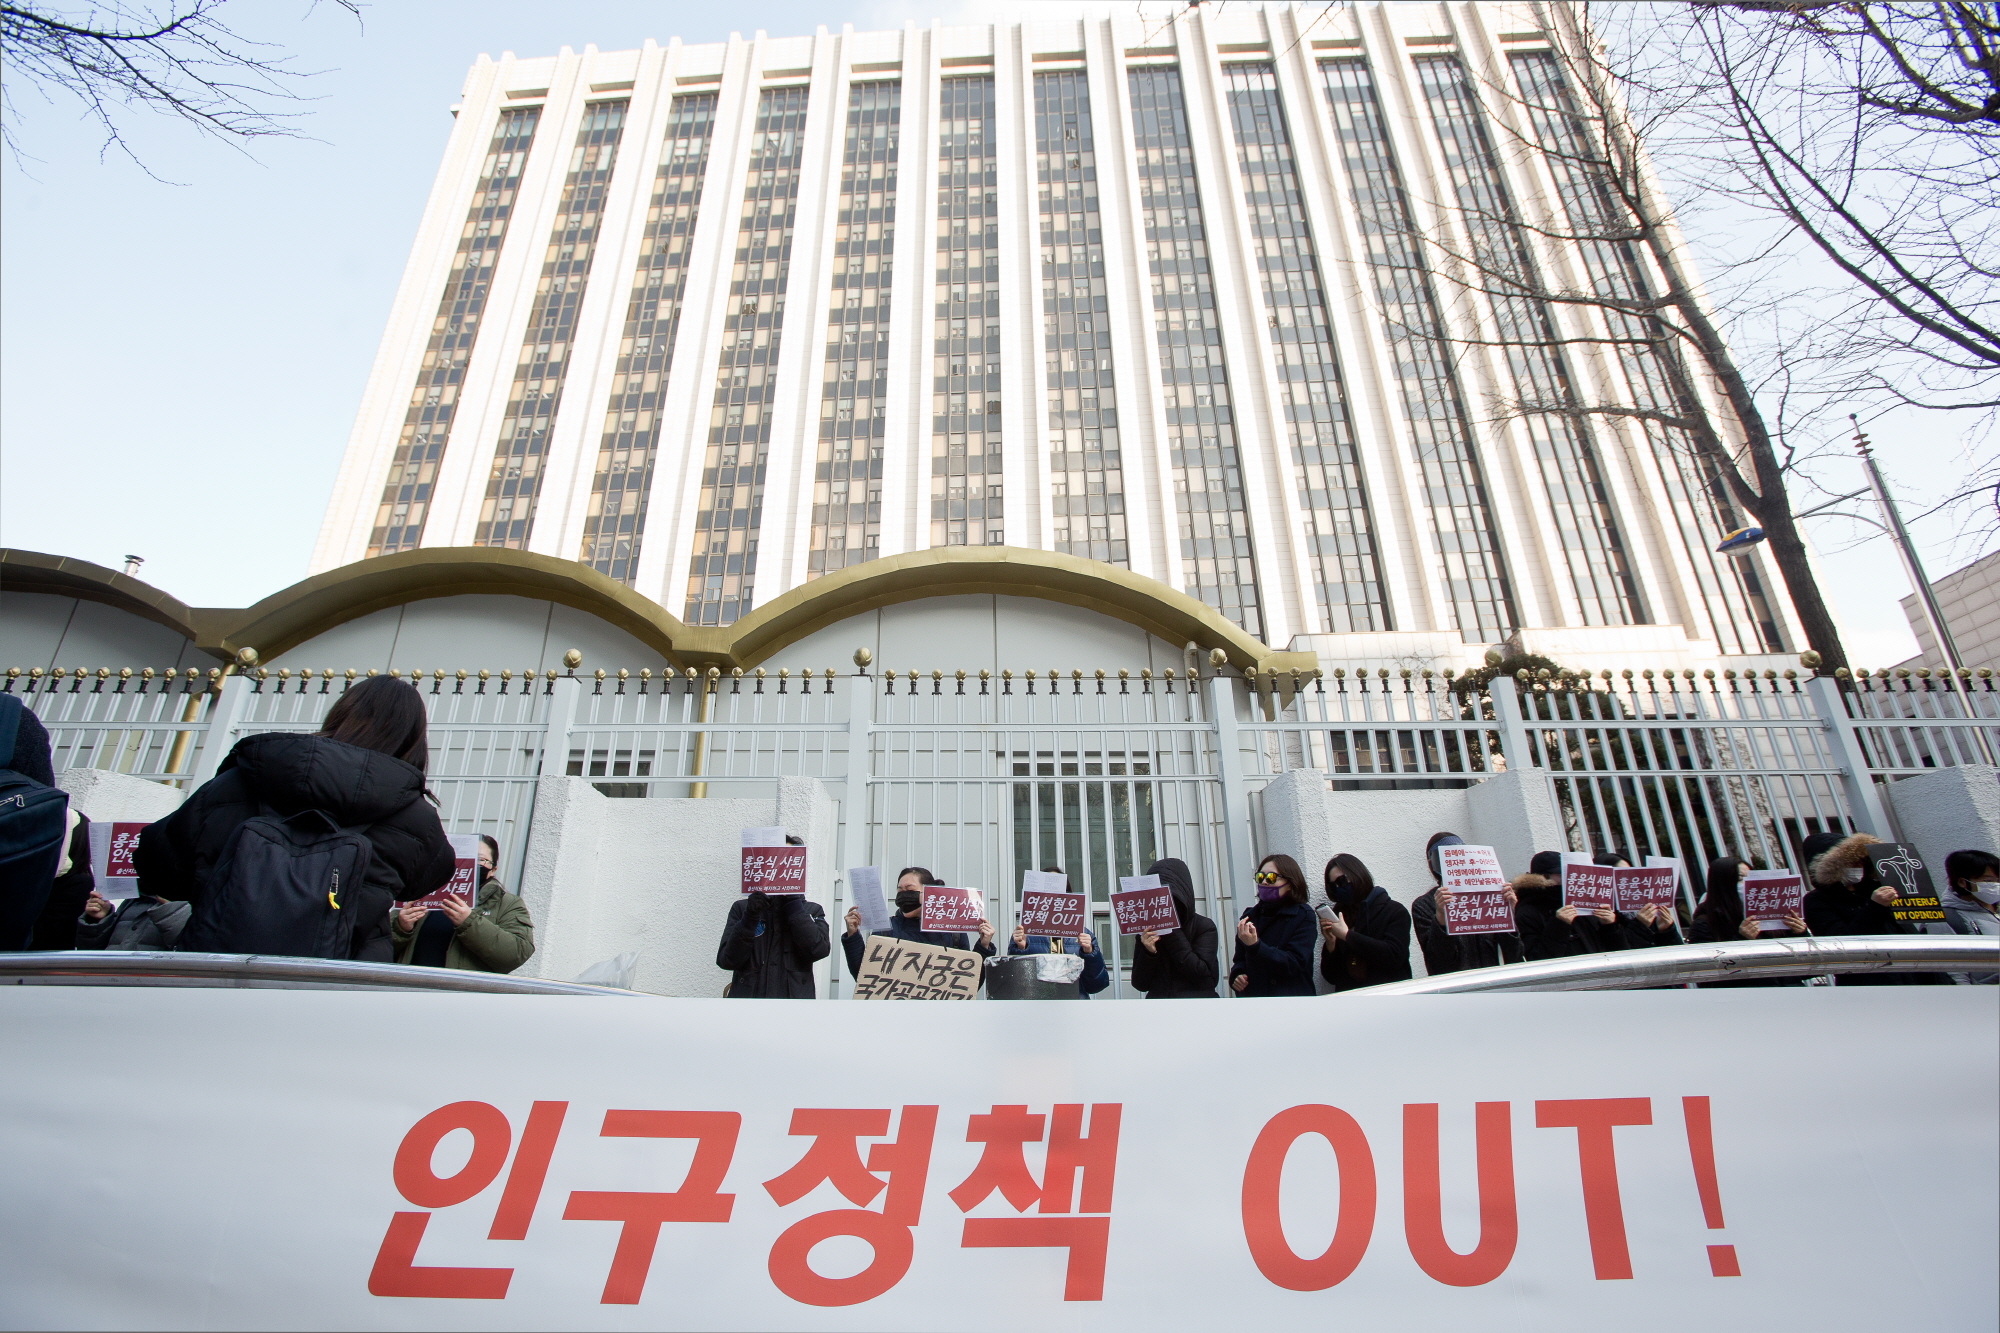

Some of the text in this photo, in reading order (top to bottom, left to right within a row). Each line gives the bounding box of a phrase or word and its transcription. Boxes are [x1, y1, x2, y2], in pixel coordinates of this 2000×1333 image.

[112, 833, 141, 848] 홍윤
[743, 856, 804, 869] 홍윤식 사퇴
[744, 868, 804, 882] 안승대 사퇴
[1568, 872, 1613, 887] 홍윤식 사퇴
[1617, 875, 1672, 890] 홍윤식 사퇴
[442, 882, 472, 895] 사퇴
[1568, 885, 1613, 899] 안승대 사퇴
[1620, 887, 1673, 901] 안승대 사퇴
[1746, 885, 1800, 900] 홍윤식 사퇴
[925, 894, 958, 908] 홍윤식
[1027, 896, 1078, 912] 여성혐오
[1116, 895, 1169, 913] 홍윤식 사퇴
[1447, 894, 1504, 909] 홍윤식 사퇴
[1748, 897, 1800, 911] 안승대 사퇴
[1891, 897, 1938, 907] MY UTERUS
[925, 908, 958, 920] 안승대
[1023, 911, 1083, 926] 정책 OUT
[1119, 907, 1172, 924] 안승대 사퇴
[1449, 906, 1508, 922] 안승대 사퇴
[1893, 911, 1945, 920] MY OPINION
[869, 944, 976, 991] 내 자궁은
[855, 974, 973, 1000] 국가공공
[369, 1096, 1740, 1306] 인구정책 OUT!
